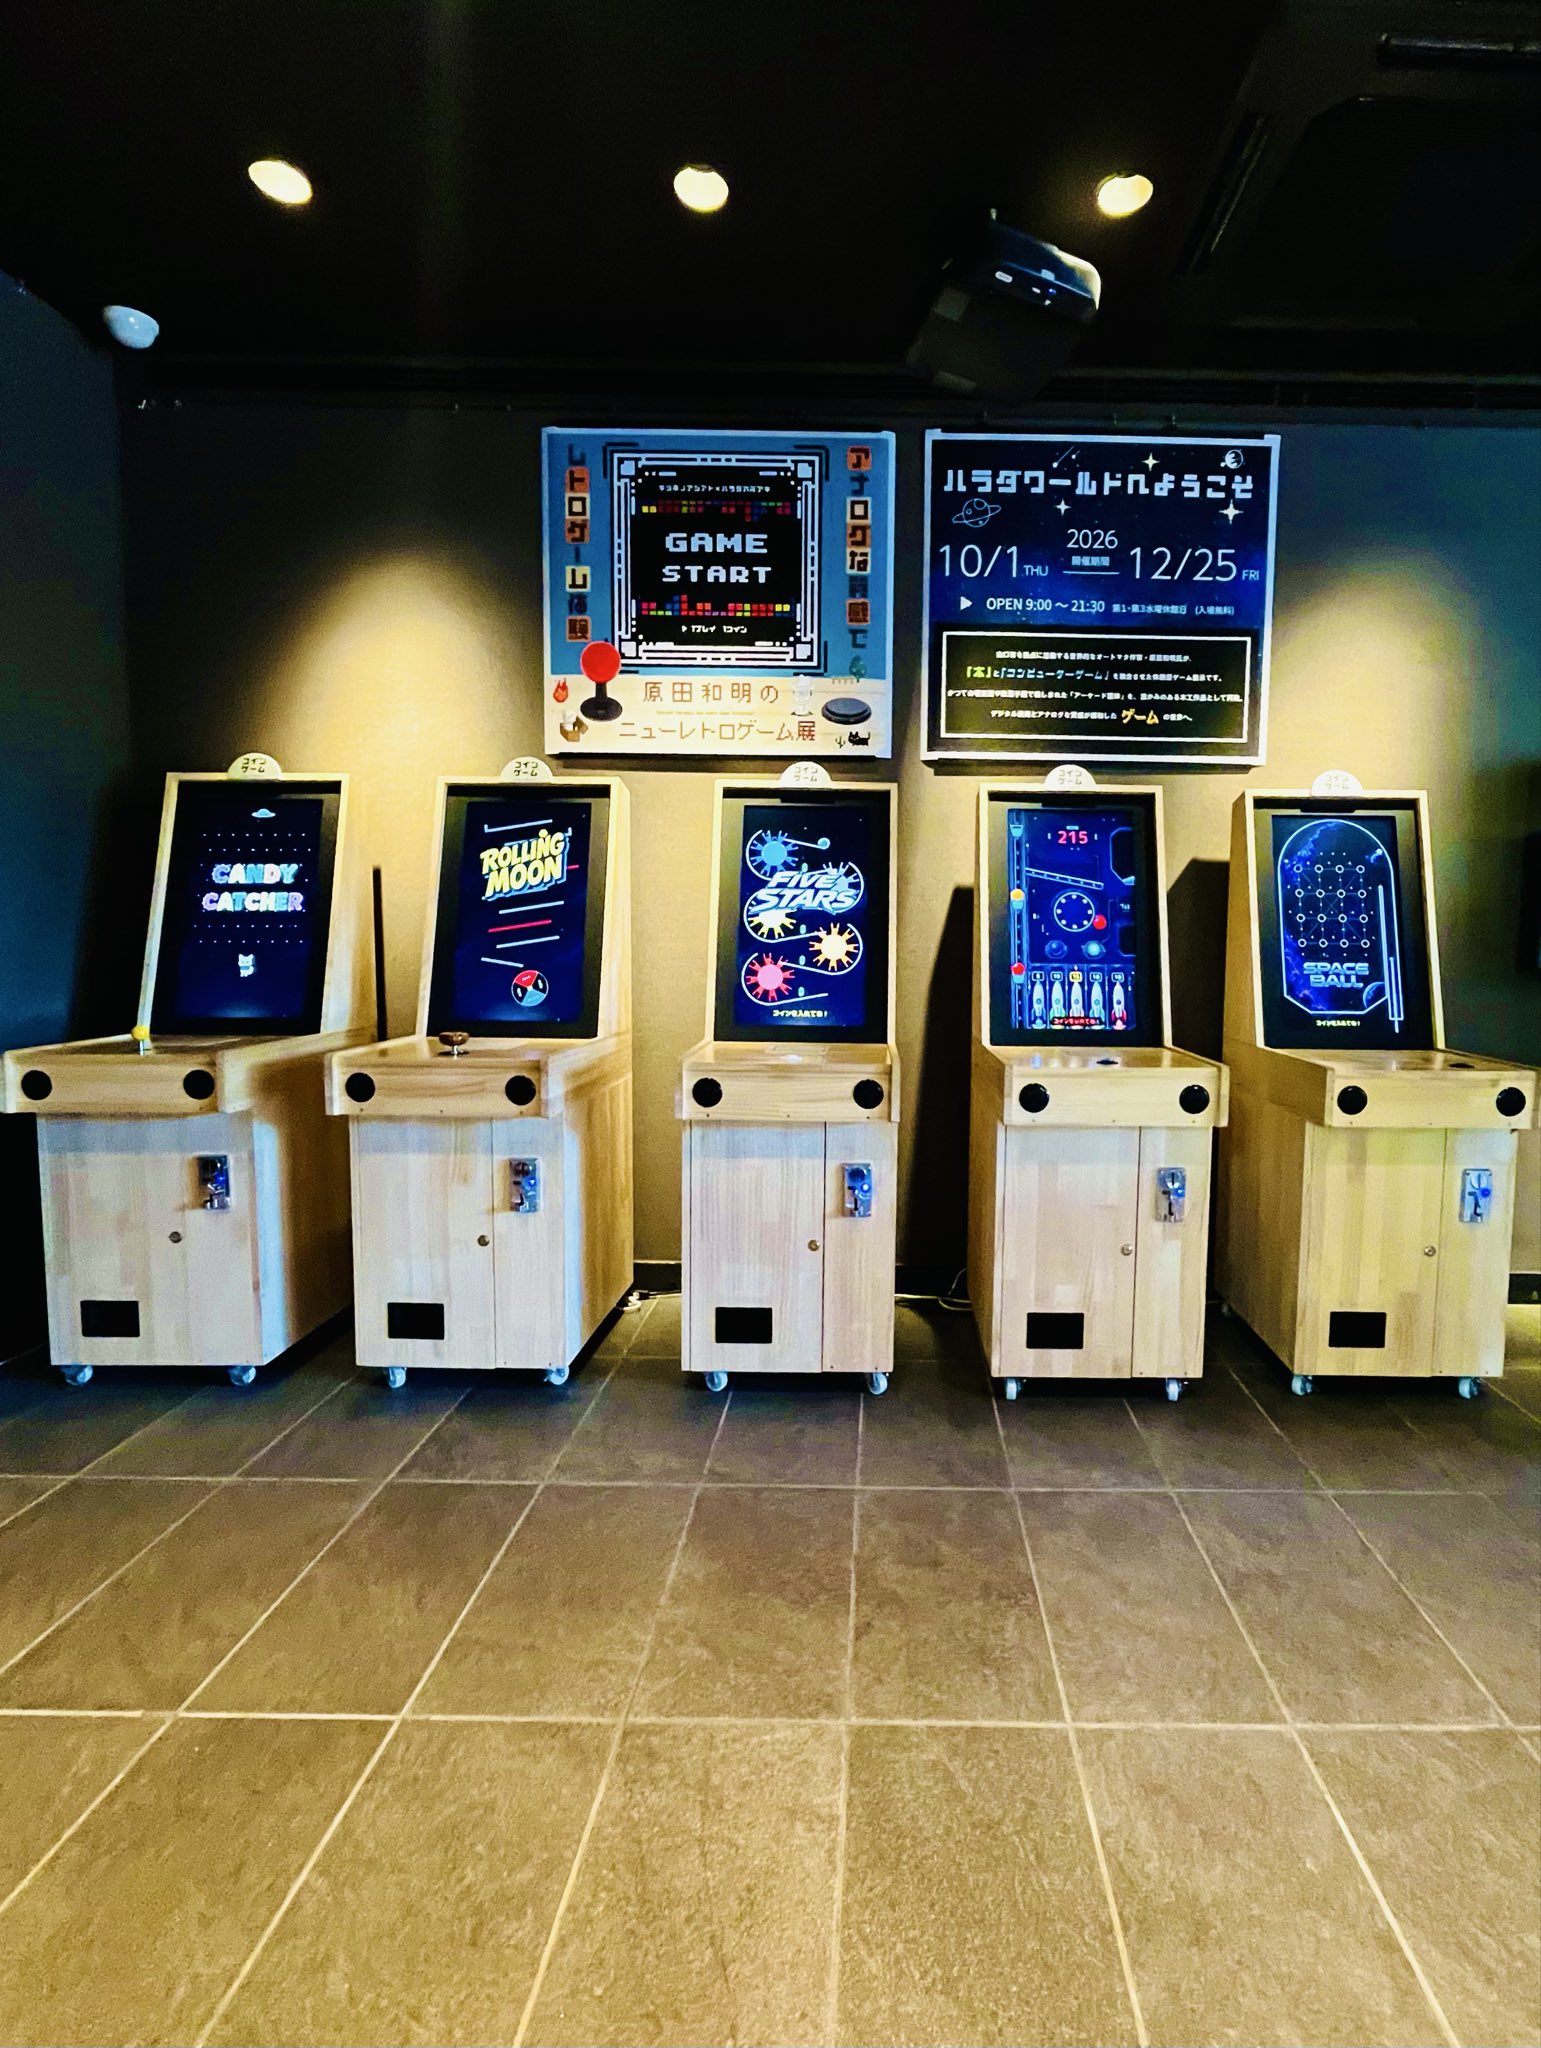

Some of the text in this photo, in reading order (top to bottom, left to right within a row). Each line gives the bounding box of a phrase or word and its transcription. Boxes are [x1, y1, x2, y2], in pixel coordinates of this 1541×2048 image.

[943, 469, 1254, 499] ハラダワールドへようこそ
[665, 532, 768, 554] GAME
[1066, 528, 1118, 549] 2026
[940, 544, 1049, 578] 10/1 THU
[1130, 547, 1260, 582] 12/25 FRI
[661, 565, 772, 584] START
[986, 598, 1023, 611] OPEN
[642, 681, 779, 704] 原田和明の
[1121, 708, 1160, 725] ゲーム
[618, 720, 816, 742] ニューレトロゲーム展
[242, 757, 266, 765] コイン
[514, 769, 538, 777] ゲーム
[1057, 830, 1088, 844] 215
[480, 829, 566, 875] ROLLING
[211, 864, 298, 884] CANDY
[485, 854, 563, 897] MOON
[767, 871, 838, 888] FIVE
[202, 892, 304, 912] CATCHER
[750, 888, 856, 912] STARS
[1303, 962, 1370, 974] SPACE
[1310, 975, 1364, 987] BALL
